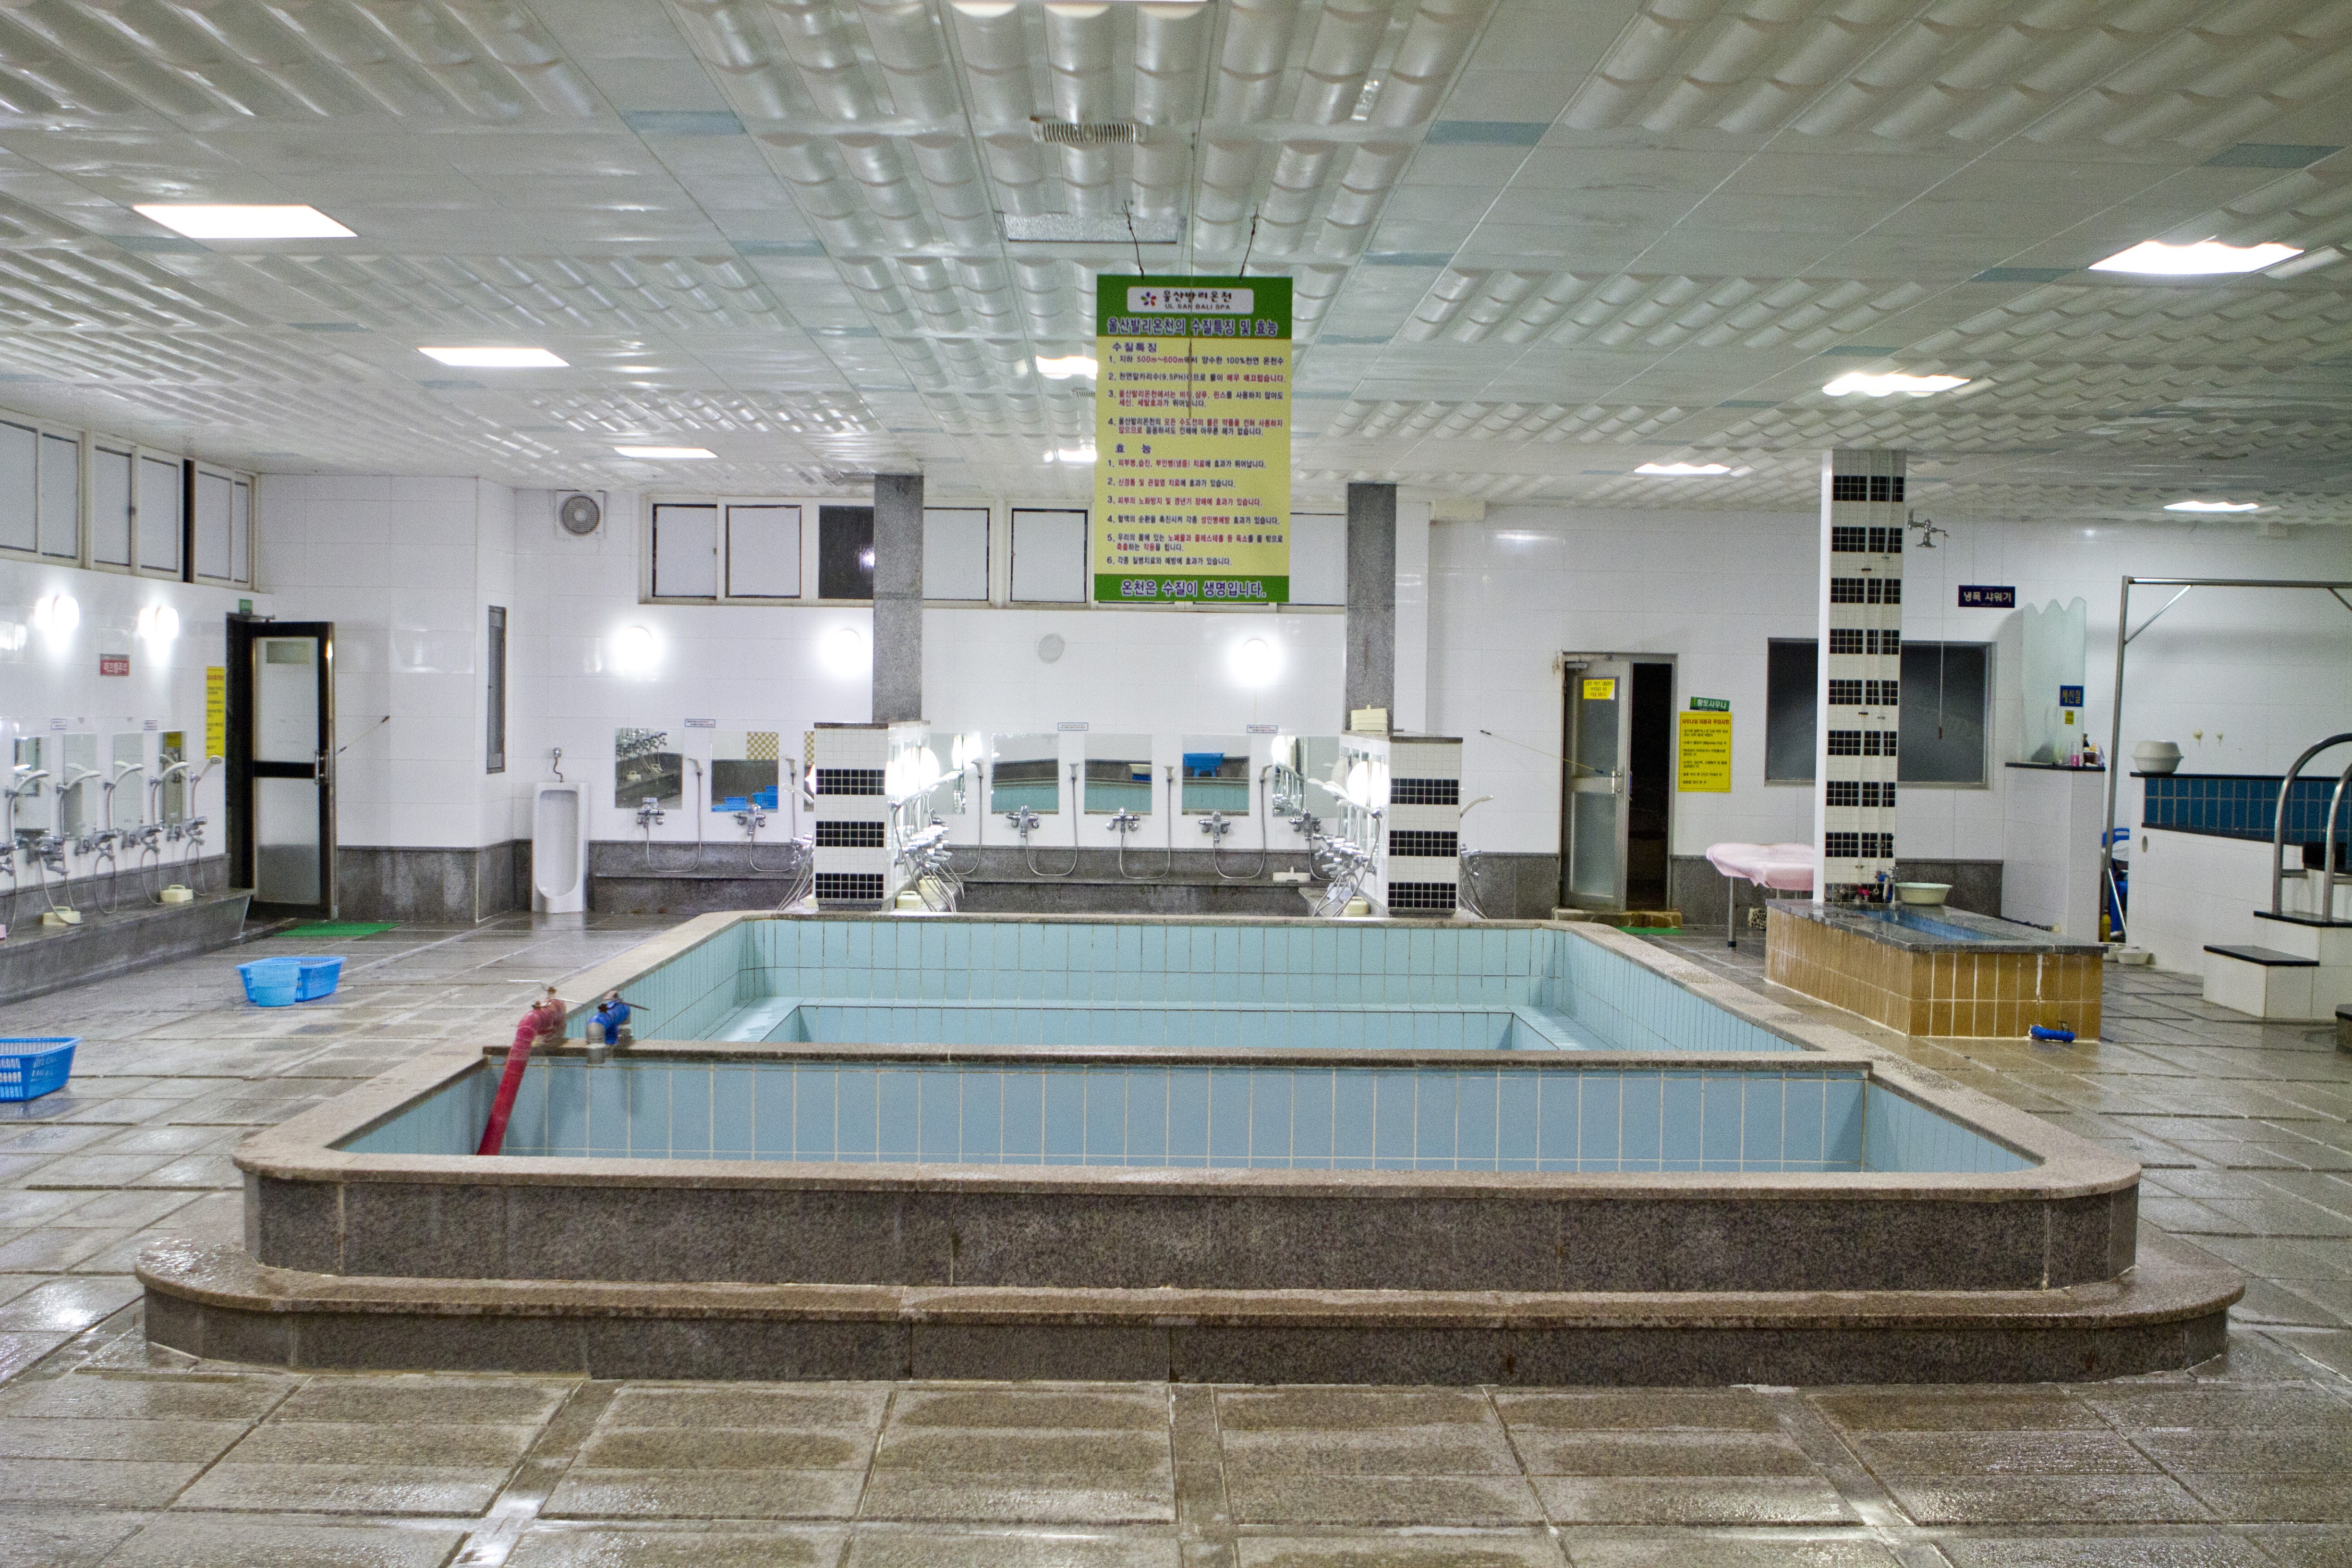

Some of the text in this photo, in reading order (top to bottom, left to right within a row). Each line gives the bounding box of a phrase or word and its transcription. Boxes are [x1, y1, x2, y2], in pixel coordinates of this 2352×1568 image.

[1108, 317, 1278, 336] 울산발리온천의 수질특징 및 효능
[1109, 355, 1116, 364] 1.
[1119, 356, 1133, 365] 지하
[1263, 358, 1284, 367] 온천수
[1108, 372, 1117, 381] 2.
[1210, 374, 1223, 383] 물이
[1226, 375, 1239, 383] 매우
[1108, 389, 1118, 398] 3.
[1236, 392, 1261, 401] 사용하지
[1264, 392, 1283, 401] 않아도
[1108, 417, 1116, 425] 4.
[1118, 417, 1162, 426] 울산발리온천의
[1164, 418, 1176, 426] 모든
[1206, 419, 1219, 427] 물은
[1243, 419, 1256, 428] 전혀
[1258, 420, 1283, 428] 사용하지
[1118, 426, 1143, 435] 않으므로
[1179, 427, 1198, 436] 인체에
[1221, 428, 1235, 436] 해가
[1237, 428, 1264, 437] 없습니다.
[1108, 459, 1115, 467] 1.
[1193, 461, 1211, 469] 치료에
[1213, 461, 1232, 469] 효과가
[1107, 478, 1236, 488] 2. 신경통 및 관절염 치료에 효과가 있습니다.
[1108, 497, 1116, 505] 3.
[1117, 497, 1136, 505] 피부의
[1139, 497, 1162, 505] 노화방지
[1165, 498, 1171, 506] 및
[1195, 498, 1212, 506] 장애에
[1215, 498, 1233, 507] 효과가
[1237, 499, 1263, 507] 있습니다.
[1107, 515, 1115, 523] 4.
[1117, 516, 1136, 524] 혈액의
[1138, 516, 1156, 524] 순환을
[1186, 517, 1198, 525] 각종
[1201, 517, 1230, 525] 성인병예방
[1233, 517, 1251, 525] 효과가
[1254, 518, 1281, 526] 있습니다.
[1107, 534, 1116, 542] 5.
[1117, 534, 1136, 542] 우리의
[1138, 534, 1151, 542] 몸에
[1152, 534, 1165, 542] 있는
[1227, 535, 1233, 543] 등
[1236, 535, 1254, 544] 독소를
[1256, 535, 1263, 544] 몸
[1265, 535, 1283, 544] 밖으로
[1143, 543, 1161, 551] 작용을
[1106, 556, 1233, 566] 6. 각종 질병치료와 예방에 효과가 있습니다.
[1121, 580, 1266, 598] 온천은 수질이 생명입니다.
[1697, 698, 1727, 709] 황토사우나
